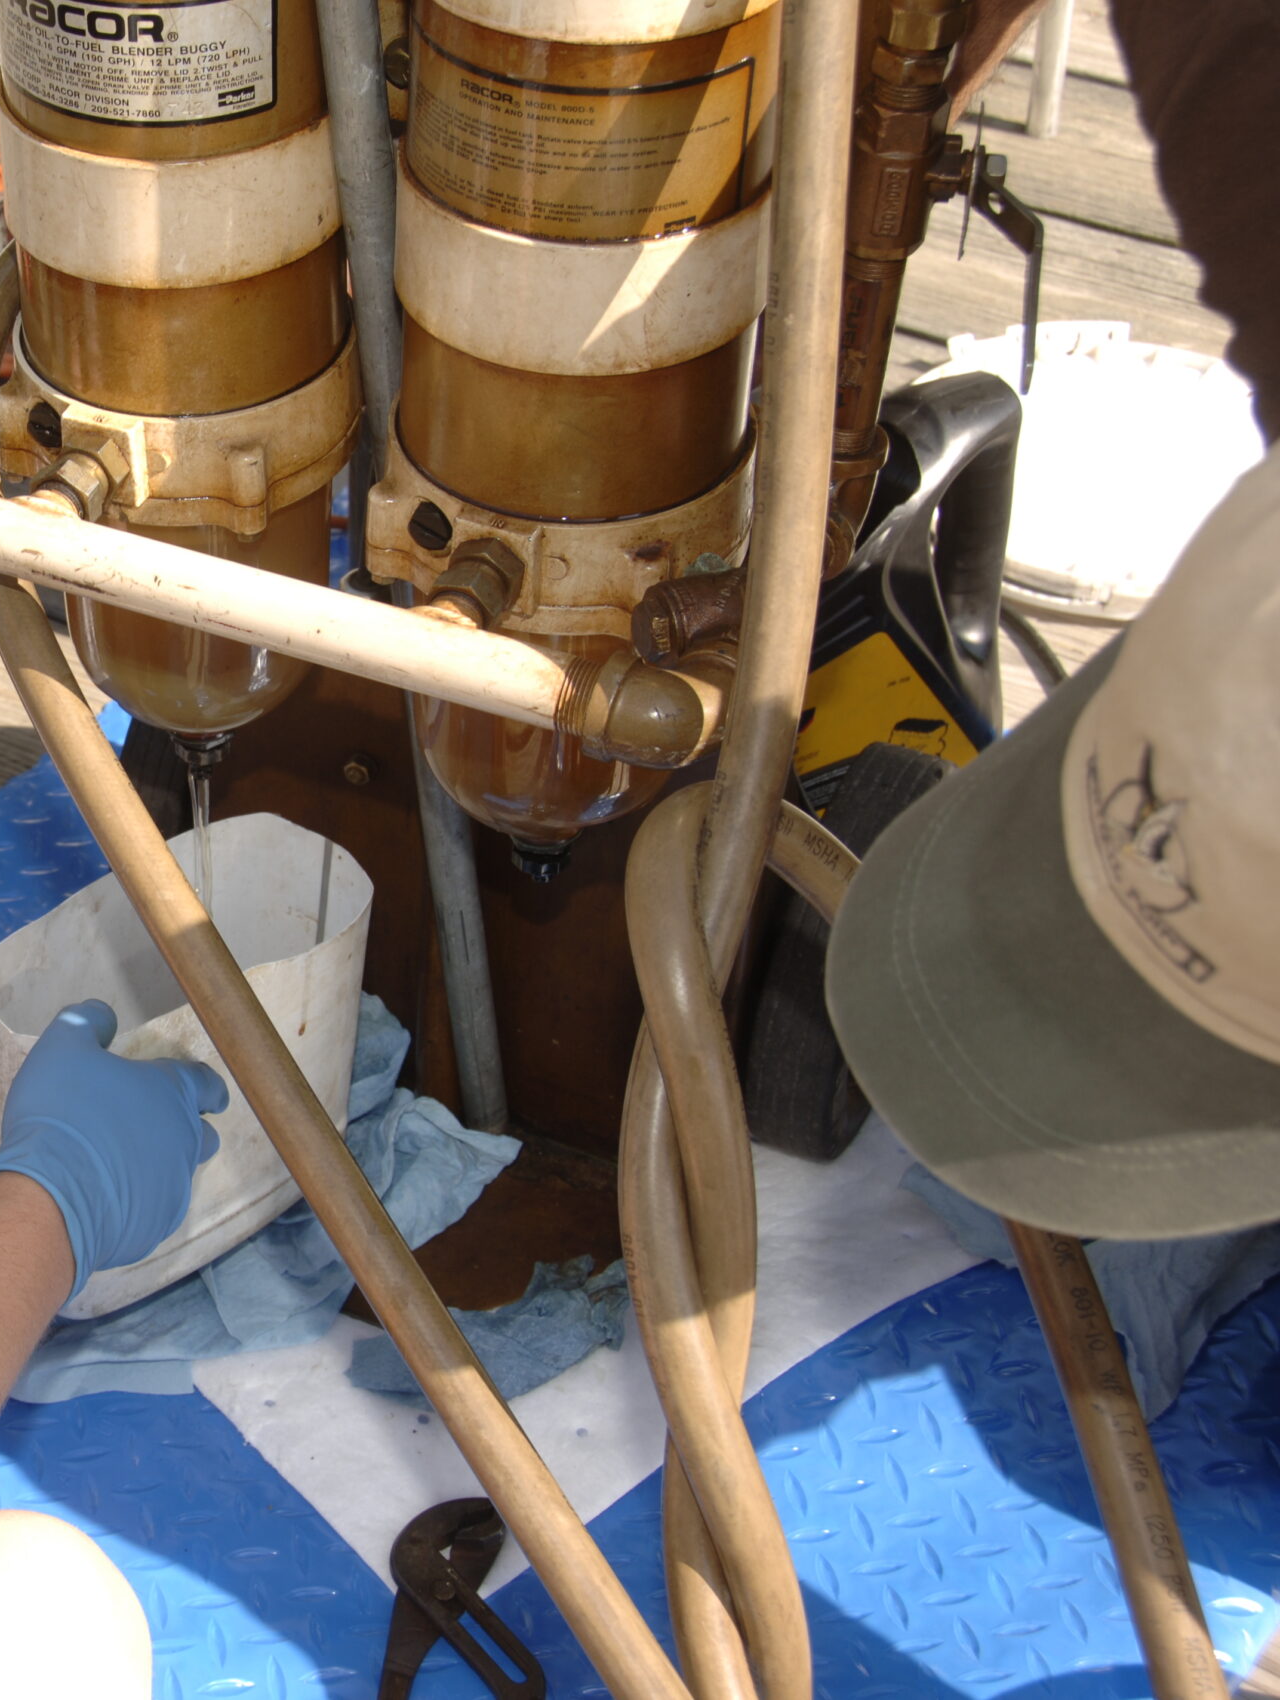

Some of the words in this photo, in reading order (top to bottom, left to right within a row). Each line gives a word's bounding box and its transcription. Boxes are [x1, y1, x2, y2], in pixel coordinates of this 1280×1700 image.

[35, 26, 104, 54] OIL-TO-FUEL
[111, 46, 173, 57] BLENDER
[180, 40, 227, 55] BUGGY
[56, 46, 77, 58] GPM
[82, 52, 103, 63] (190
[108, 56, 135, 67] GPH)
[151, 58, 162, 67] 12
[168, 57, 191, 66] LPM
[197, 53, 220, 65] (720
[225, 46, 250, 59] LPH)
[73, 61, 103, 73] MOTOR
[131, 69, 169, 77] REMOVE
[174, 68, 189, 76] LID
[242, 55, 263, 65] PULL
[56, 63, 91, 78] ELEMENT
[170, 73, 212, 84] REPLACE
[48, 82, 80, 99] RACOR
[85, 93, 129, 106] DIVISION
[224, 89, 255, 105] Parker
[91, 104, 161, 118] 209-521-7860
[459, 90, 501, 113] OPERATION
[504, 107, 524, 118] AND
[526, 112, 596, 127] MAINTENANCE
[525, 100, 557, 112] MODEL
[592, 208, 617, 216] WEAR
[803, 829, 842, 863] MSHA
[1071, 1286, 1110, 1351] 801-10
[1144, 1513, 1175, 1560] (250
[1183, 1636, 1215, 1696] MSHA
